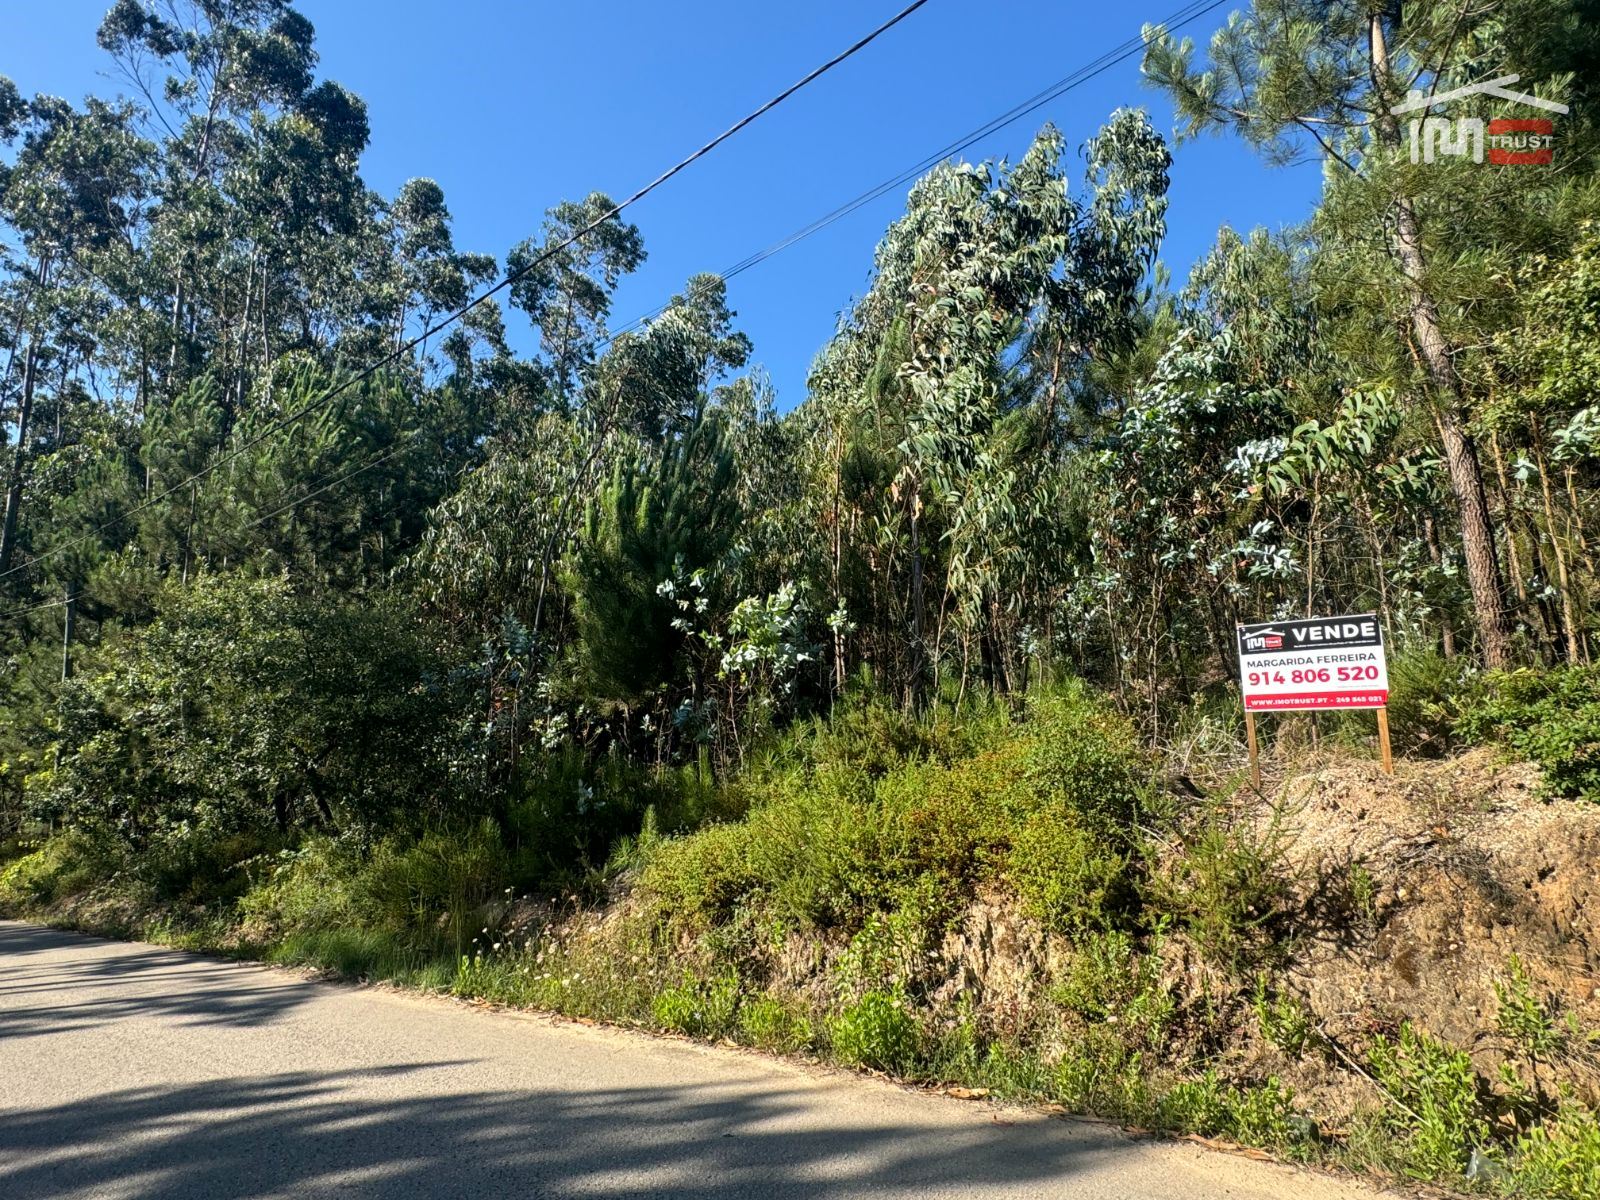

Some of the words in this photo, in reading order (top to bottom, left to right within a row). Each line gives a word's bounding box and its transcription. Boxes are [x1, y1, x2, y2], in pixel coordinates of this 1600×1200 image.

[1292, 622, 1377, 642] VENDE
[1247, 656, 1314, 668] MARGARIDA
[1317, 652, 1377, 664] FERREIRA
[1248, 670, 1286, 686] 914
[1291, 668, 1331, 684] 806
[1337, 665, 1379, 682] 520
[1250, 697, 1328, 706] WWW.IMOTRUST.PT
